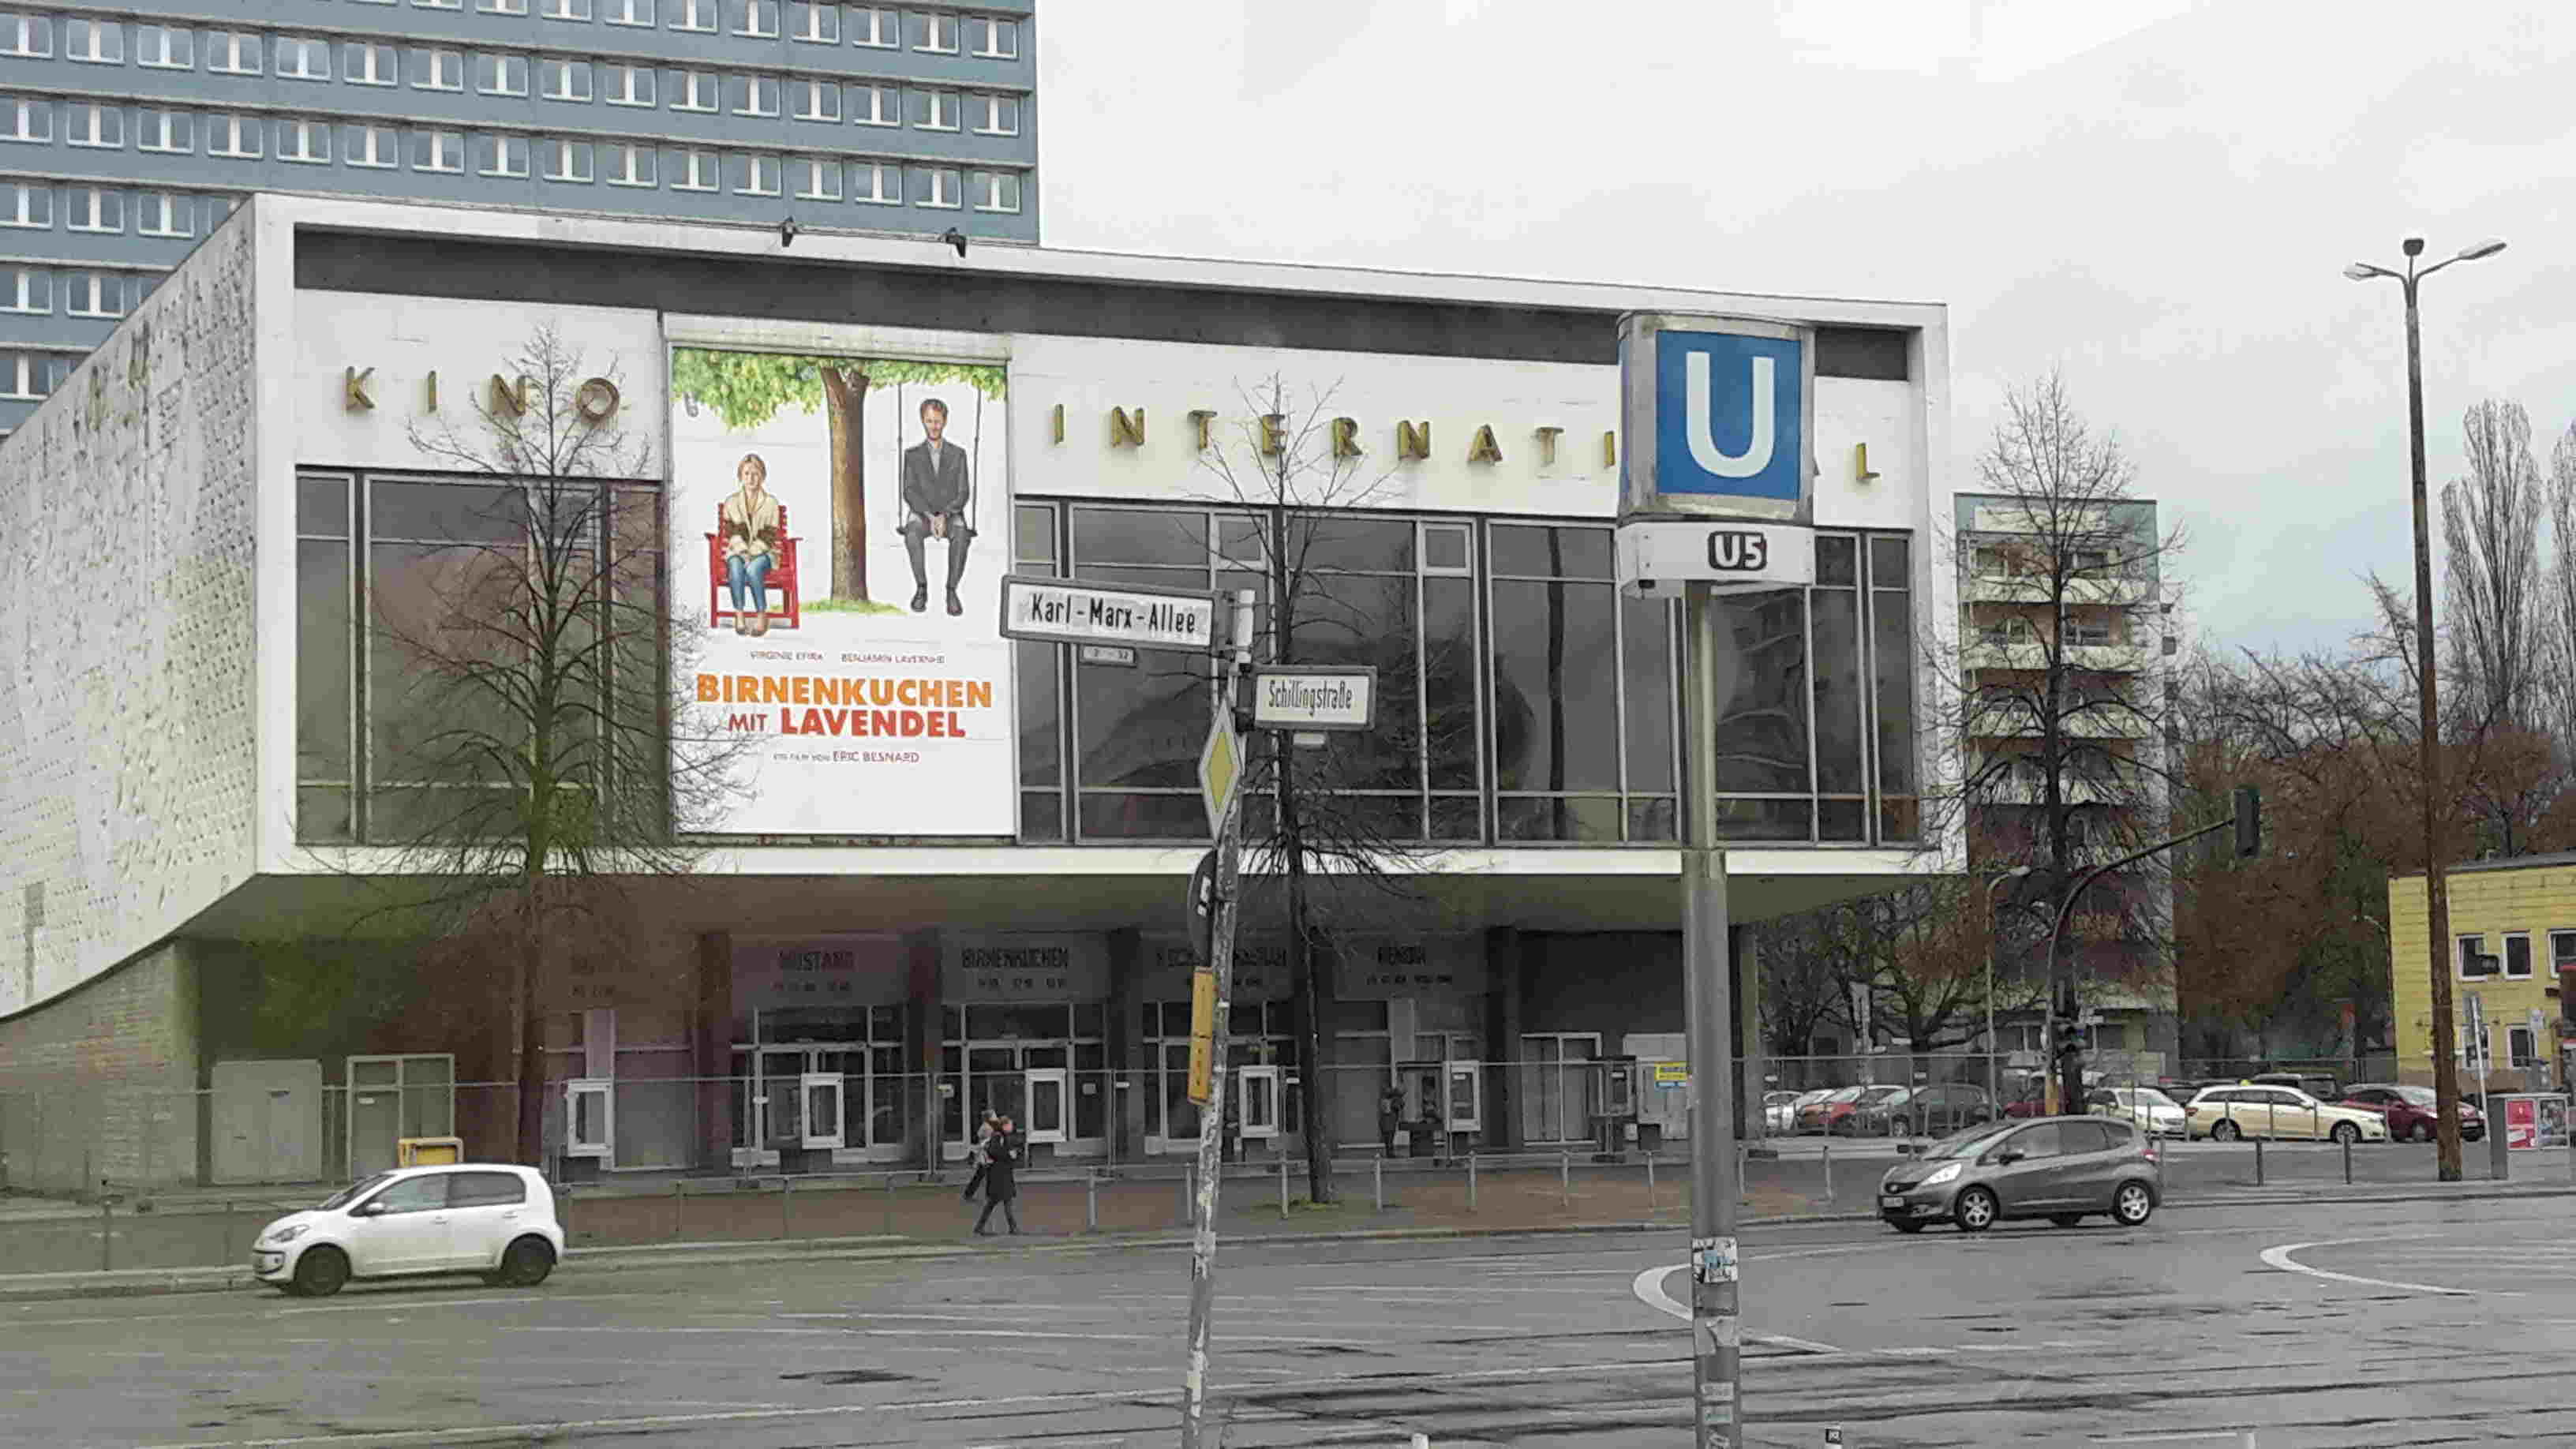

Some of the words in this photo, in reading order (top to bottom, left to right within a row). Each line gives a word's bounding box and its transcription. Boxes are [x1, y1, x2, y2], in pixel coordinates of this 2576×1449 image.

[345, 365, 620, 423] KINO
[1052, 402, 1881, 481] INTERNATIL
[1686, 350, 1775, 478] U
[1713, 533, 1766, 569] U5
[1031, 592, 1196, 634] Karl-Marx-Allee
[695, 673, 993, 709] BIRNENKUCHEN
[1268, 679, 1354, 717] Schillingstraße
[728, 713, 769, 732] MIT
[781, 707, 967, 739] LAVENDEL
[863, 751, 920, 763] BESNARD
